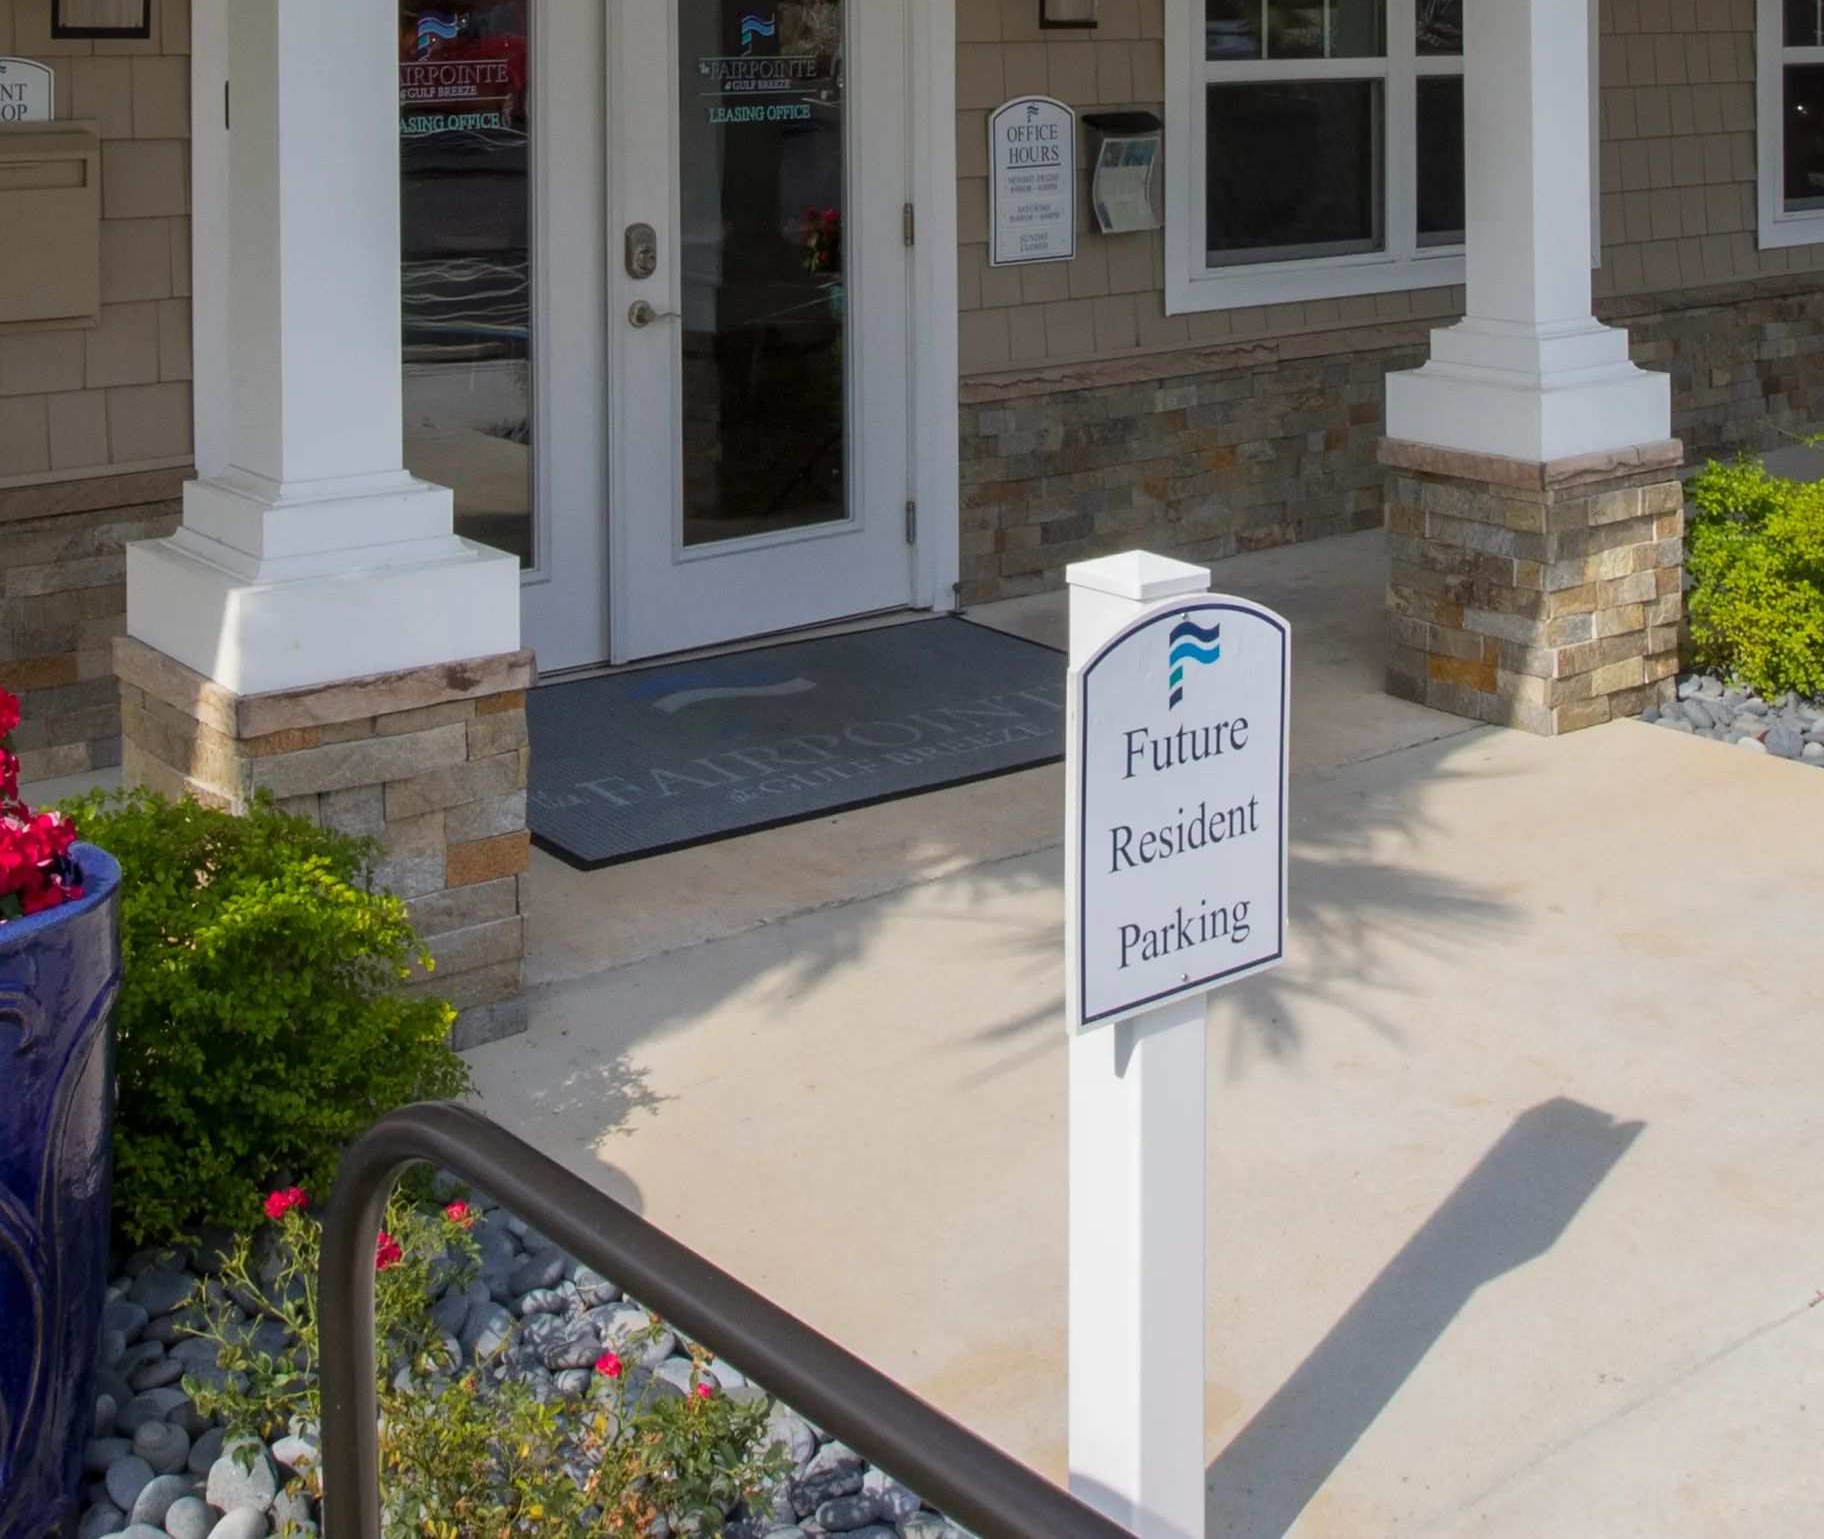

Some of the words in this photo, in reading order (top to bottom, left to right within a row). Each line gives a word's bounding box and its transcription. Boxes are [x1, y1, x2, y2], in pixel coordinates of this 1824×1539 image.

[710, 60, 817, 79] FAIRPOINTE
[407, 87, 435, 98] GULF
[437, 85, 478, 97] BREEZE
[732, 80, 756, 90] GULF
[757, 79, 791, 89] BREEZE
[399, 114, 444, 133] ASING
[447, 112, 499, 131] OFFICE
[709, 106, 764, 122] LEASING
[766, 104, 811, 120] OFFICE
[1007, 123, 1058, 142] OFFICE
[1009, 144, 1060, 164] HOURS
[574, 681, 1065, 807] FAIRPOINT
[1121, 715, 1251, 781] Future
[758, 760, 878, 794] GULF
[1107, 793, 1260, 875] Resident
[1117, 898, 1252, 971] Parking
